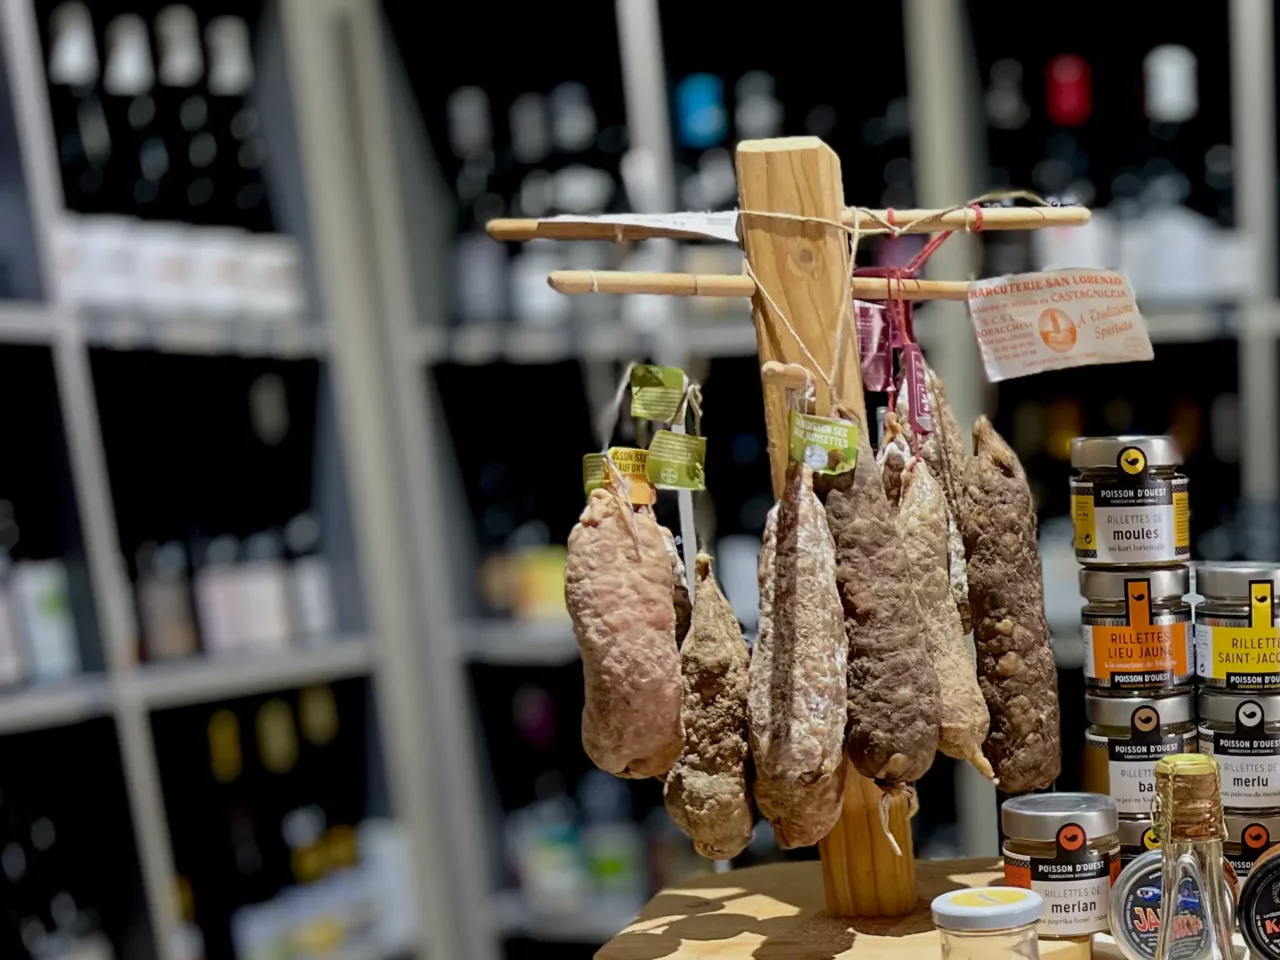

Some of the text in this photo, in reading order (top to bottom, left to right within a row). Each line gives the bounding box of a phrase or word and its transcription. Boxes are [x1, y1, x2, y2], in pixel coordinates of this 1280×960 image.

[1045, 276, 1070, 288] SAN
[1073, 275, 1123, 286] LORENZO
[1101, 488, 1167, 498] POISSON D'OUEST
[1107, 513, 1163, 525] RILLETTES DE
[1113, 528, 1160, 541] moules
[1111, 631, 1171, 644] RILLETTES
[1108, 644, 1174, 659] LIEU JAUNE
[1115, 673, 1171, 684] POISSON D'OUEST
[1230, 675, 1263, 684] POISSON
[1115, 743, 1178, 754] POISSON D'OUEST
[1220, 739, 1249, 748] POISSON
[1224, 763, 1277, 773] RILLETTES DE
[1233, 776, 1269, 787] merlu
[1230, 791, 1248, 799] poivres
[1038, 861, 1104, 873] POISSON D'OUEST
[1044, 885, 1101, 898] RILLETTES DE
[1051, 901, 1096, 913] merlan
[1047, 917, 1073, 925] paprika
